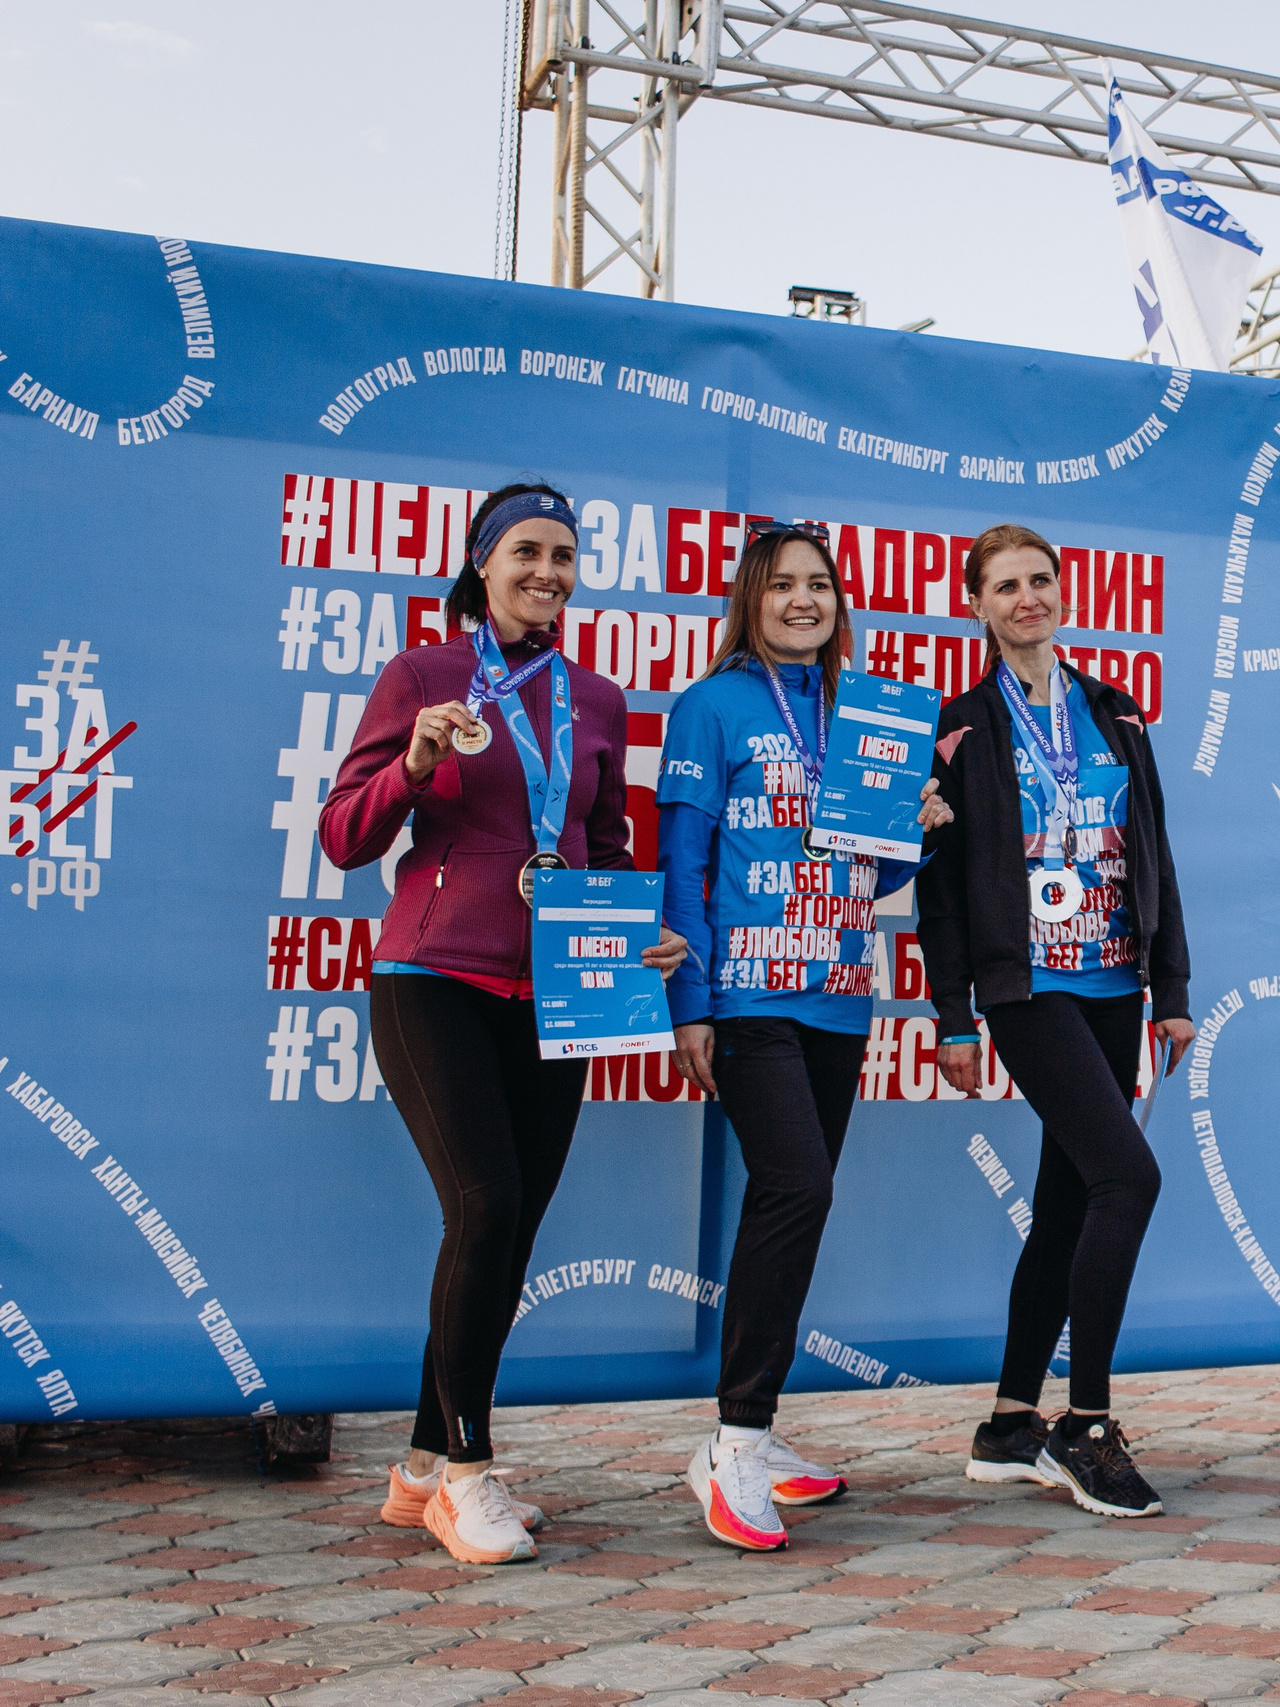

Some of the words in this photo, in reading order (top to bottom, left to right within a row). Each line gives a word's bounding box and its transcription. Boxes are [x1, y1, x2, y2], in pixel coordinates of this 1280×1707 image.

[154, 236, 193, 267] НО
[166, 265, 216, 359] ВЕЛИКИЙ
[8, 372, 100, 440] БАРНАУЛ
[117, 374, 215, 446] БЕЛГОРОД
[319, 356, 416, 435] ВОЛГОГРАД
[423, 347, 507, 376] ВОЛОГДА
[520, 349, 606, 388] ВОРОНЕЖ
[617, 366, 689, 405] ГАТЧИНА
[702, 386, 829, 444] ГОРНО-АЛТАЙСК
[838, 427, 949, 474] ЕКАТЕРИНБУРГ
[959, 455, 1025, 484] ЗАРАЙСК
[1036, 455, 1100, 485] ИЖЕВСК
[1106, 412, 1169, 470] ИРКУТСК
[1240, 441, 1280, 507] МАЙКОП
[281, 474, 492, 578] #ЦЕЛ
[1222, 513, 1255, 604] МАХАЧКАЛА
[1213, 614, 1240, 679] МОСКВА
[14, 684, 115, 774] ЗА
[1002, 674, 1033, 722] САХАЛИНСКАЯ
[1029, 721, 1052, 754] ОБЛАСТЬ
[1192, 689, 1231, 777] МУРМАНСК
[668, 760, 704, 779] ПСБ
[748, 733, 800, 762] 202
[865, 736, 909, 764] МЕСТО
[861, 770, 875, 788] 10
[876, 771, 892, 790] КМ
[0, 770, 133, 859] БЕГ
[839, 838, 857, 847] ПСБ
[874, 844, 900, 854] FONBET
[747, 861, 833, 894] #ЗАБЕГ
[580, 936, 628, 958] МЕСТО
[729, 927, 842, 961] #ЛЮБОВЬ
[580, 971, 594, 988] 10
[595, 971, 614, 988] КМ
[720, 960, 807, 990] #ЗАБЕГ
[576, 1043, 598, 1052] ПСБ
[621, 1040, 651, 1048] FONBET
[1187, 989, 1244, 1100] ПЕТРОЗАВОДСК
[966, 1133, 1015, 1198] ТЮМЕНЬ
[5, 1071, 100, 1161] ХАБАРОВСК
[90, 1155, 209, 1299] ХАНТЫ-МАНСИЙСК
[197, 1298, 267, 1398] ЧЕЛЯБИНСК
[648, 1263, 725, 1309] САРАНСК
[803, 1329, 890, 1387] СМОЛЕНСК
[35, 1368, 79, 1417] ЯЛТА
